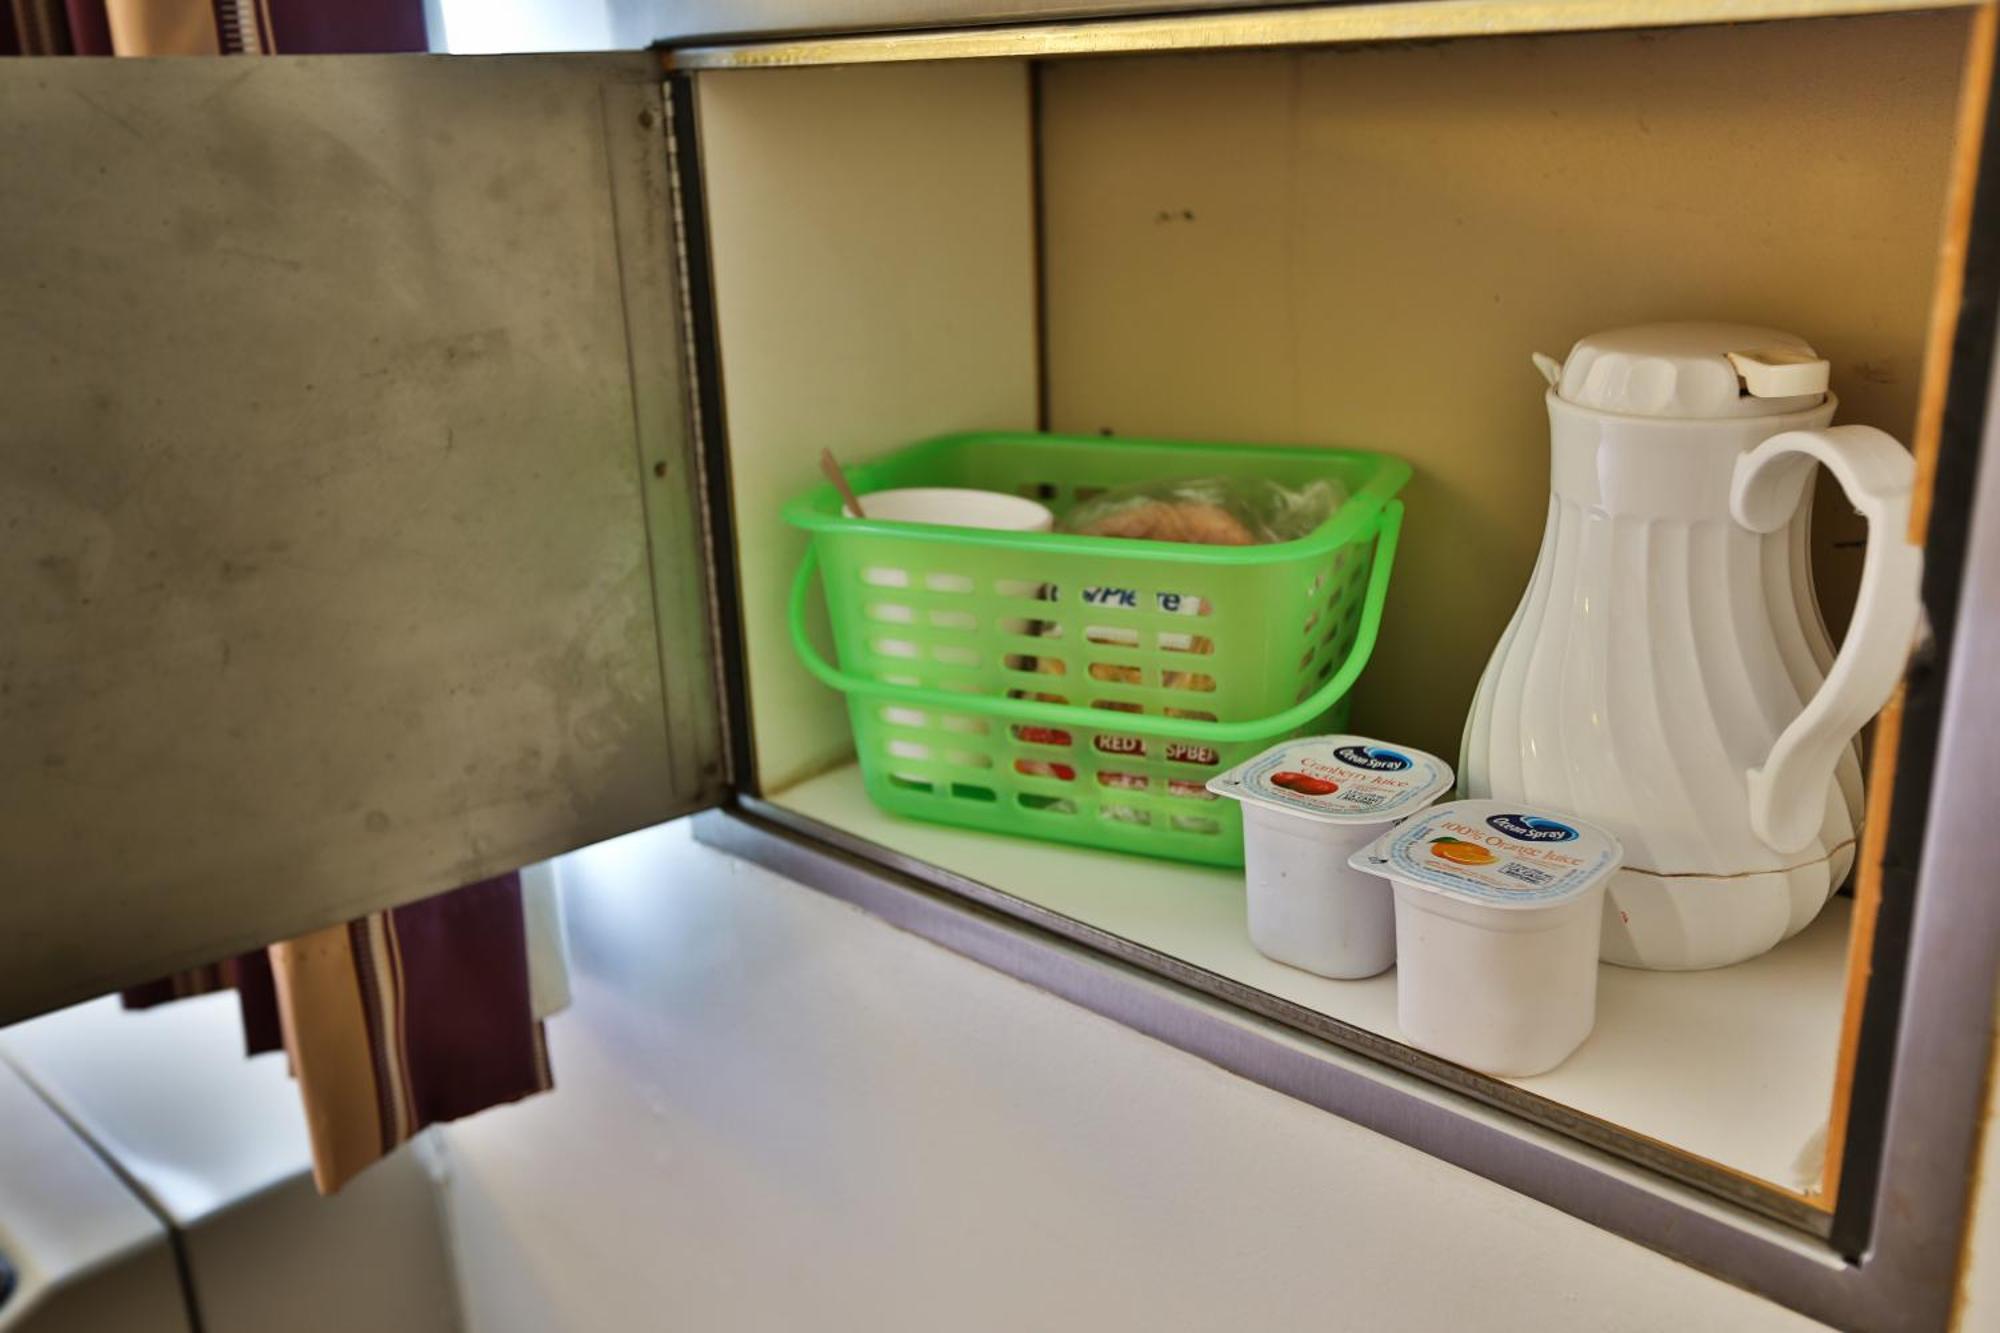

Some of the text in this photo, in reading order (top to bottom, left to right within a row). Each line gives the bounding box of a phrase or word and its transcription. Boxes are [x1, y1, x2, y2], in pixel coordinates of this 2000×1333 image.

[1099, 735, 1135, 753] RED
[1367, 759, 1401, 769] Spray
[1493, 817, 1566, 839] Ocean Spray
[1441, 821, 1485, 840] 100%
[1486, 836, 1541, 856] Orange
[1542, 850, 1583, 866] Juice
